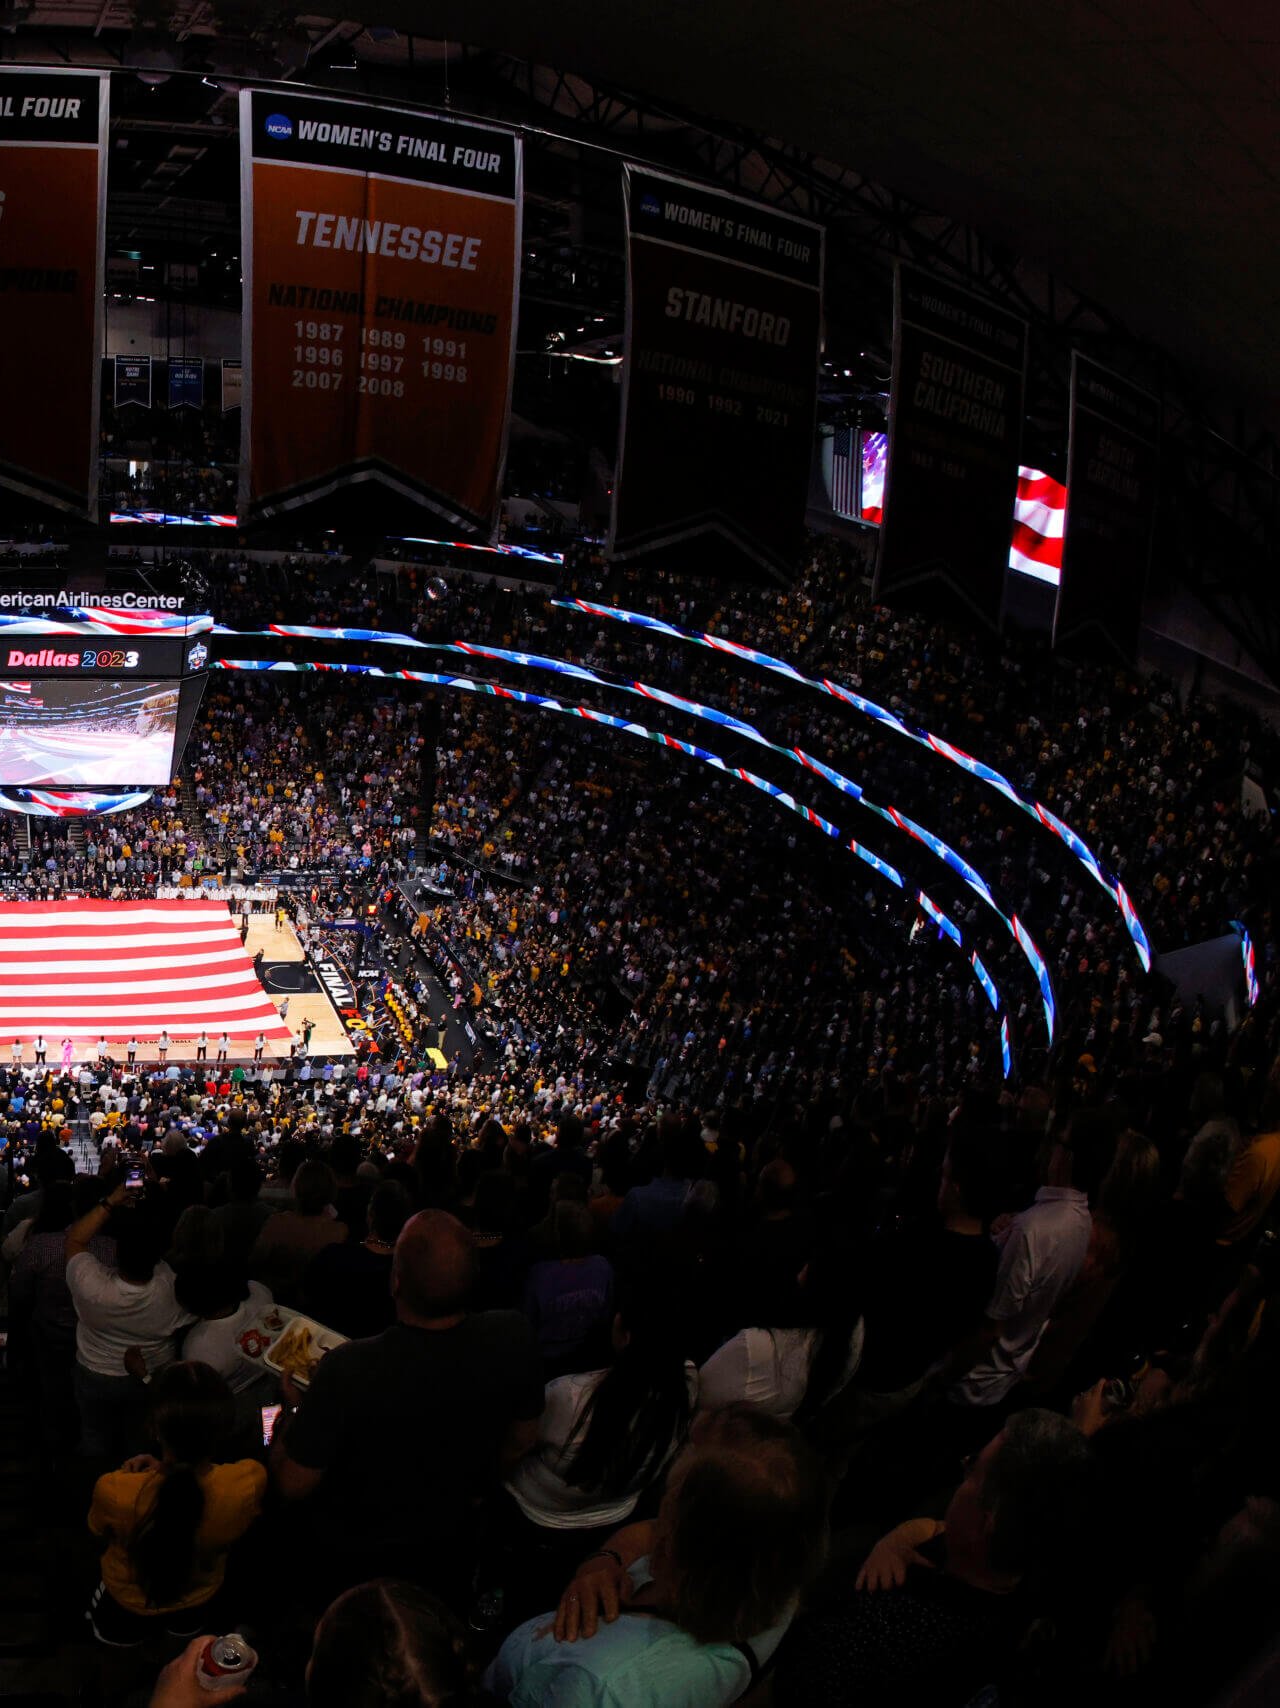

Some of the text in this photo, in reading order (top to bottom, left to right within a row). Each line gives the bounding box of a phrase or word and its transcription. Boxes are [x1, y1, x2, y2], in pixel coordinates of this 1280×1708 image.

[21, 97, 81, 119] FOUR
[267, 124, 293, 135] NCAA
[297, 120, 502, 174] WOMEN'S FINAL FOUR
[295, 209, 482, 271] TENNESSEE
[664, 200, 812, 264] WOMEN'S FINAL FOUR
[268, 283, 498, 335] NATIONAL CHAMPIONS
[664, 286, 793, 348] STANFORD
[293, 320, 468, 360] 1987 1989 1991
[292, 369, 406, 399] 2007 2008
[293, 345, 468, 384] 1996 1997 1998
[919, 351, 1006, 409] SOUTHERN
[912, 380, 1008, 439] CALIFORNIA
[7, 649, 140, 668] Dallas 2023
[318, 962, 354, 1007] FINAL
